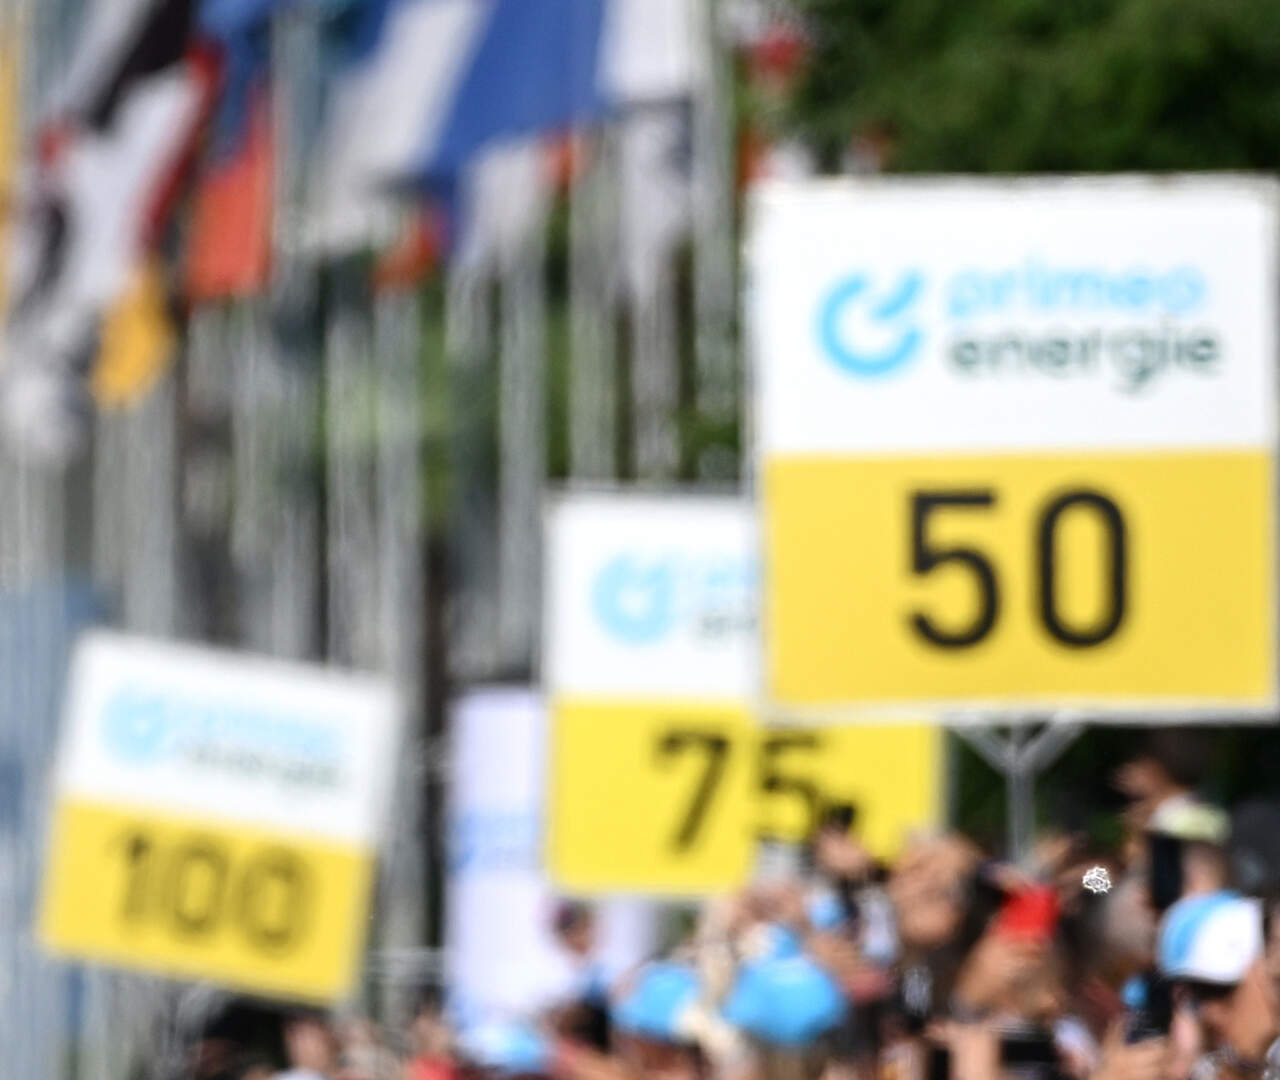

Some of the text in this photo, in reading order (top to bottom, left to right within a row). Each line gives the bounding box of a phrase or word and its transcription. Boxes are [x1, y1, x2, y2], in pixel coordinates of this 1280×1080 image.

[946, 320, 1224, 398] energie
[906, 484, 1128, 653] 50
[652, 726, 824, 854] 75
[112, 828, 322, 957] 100
